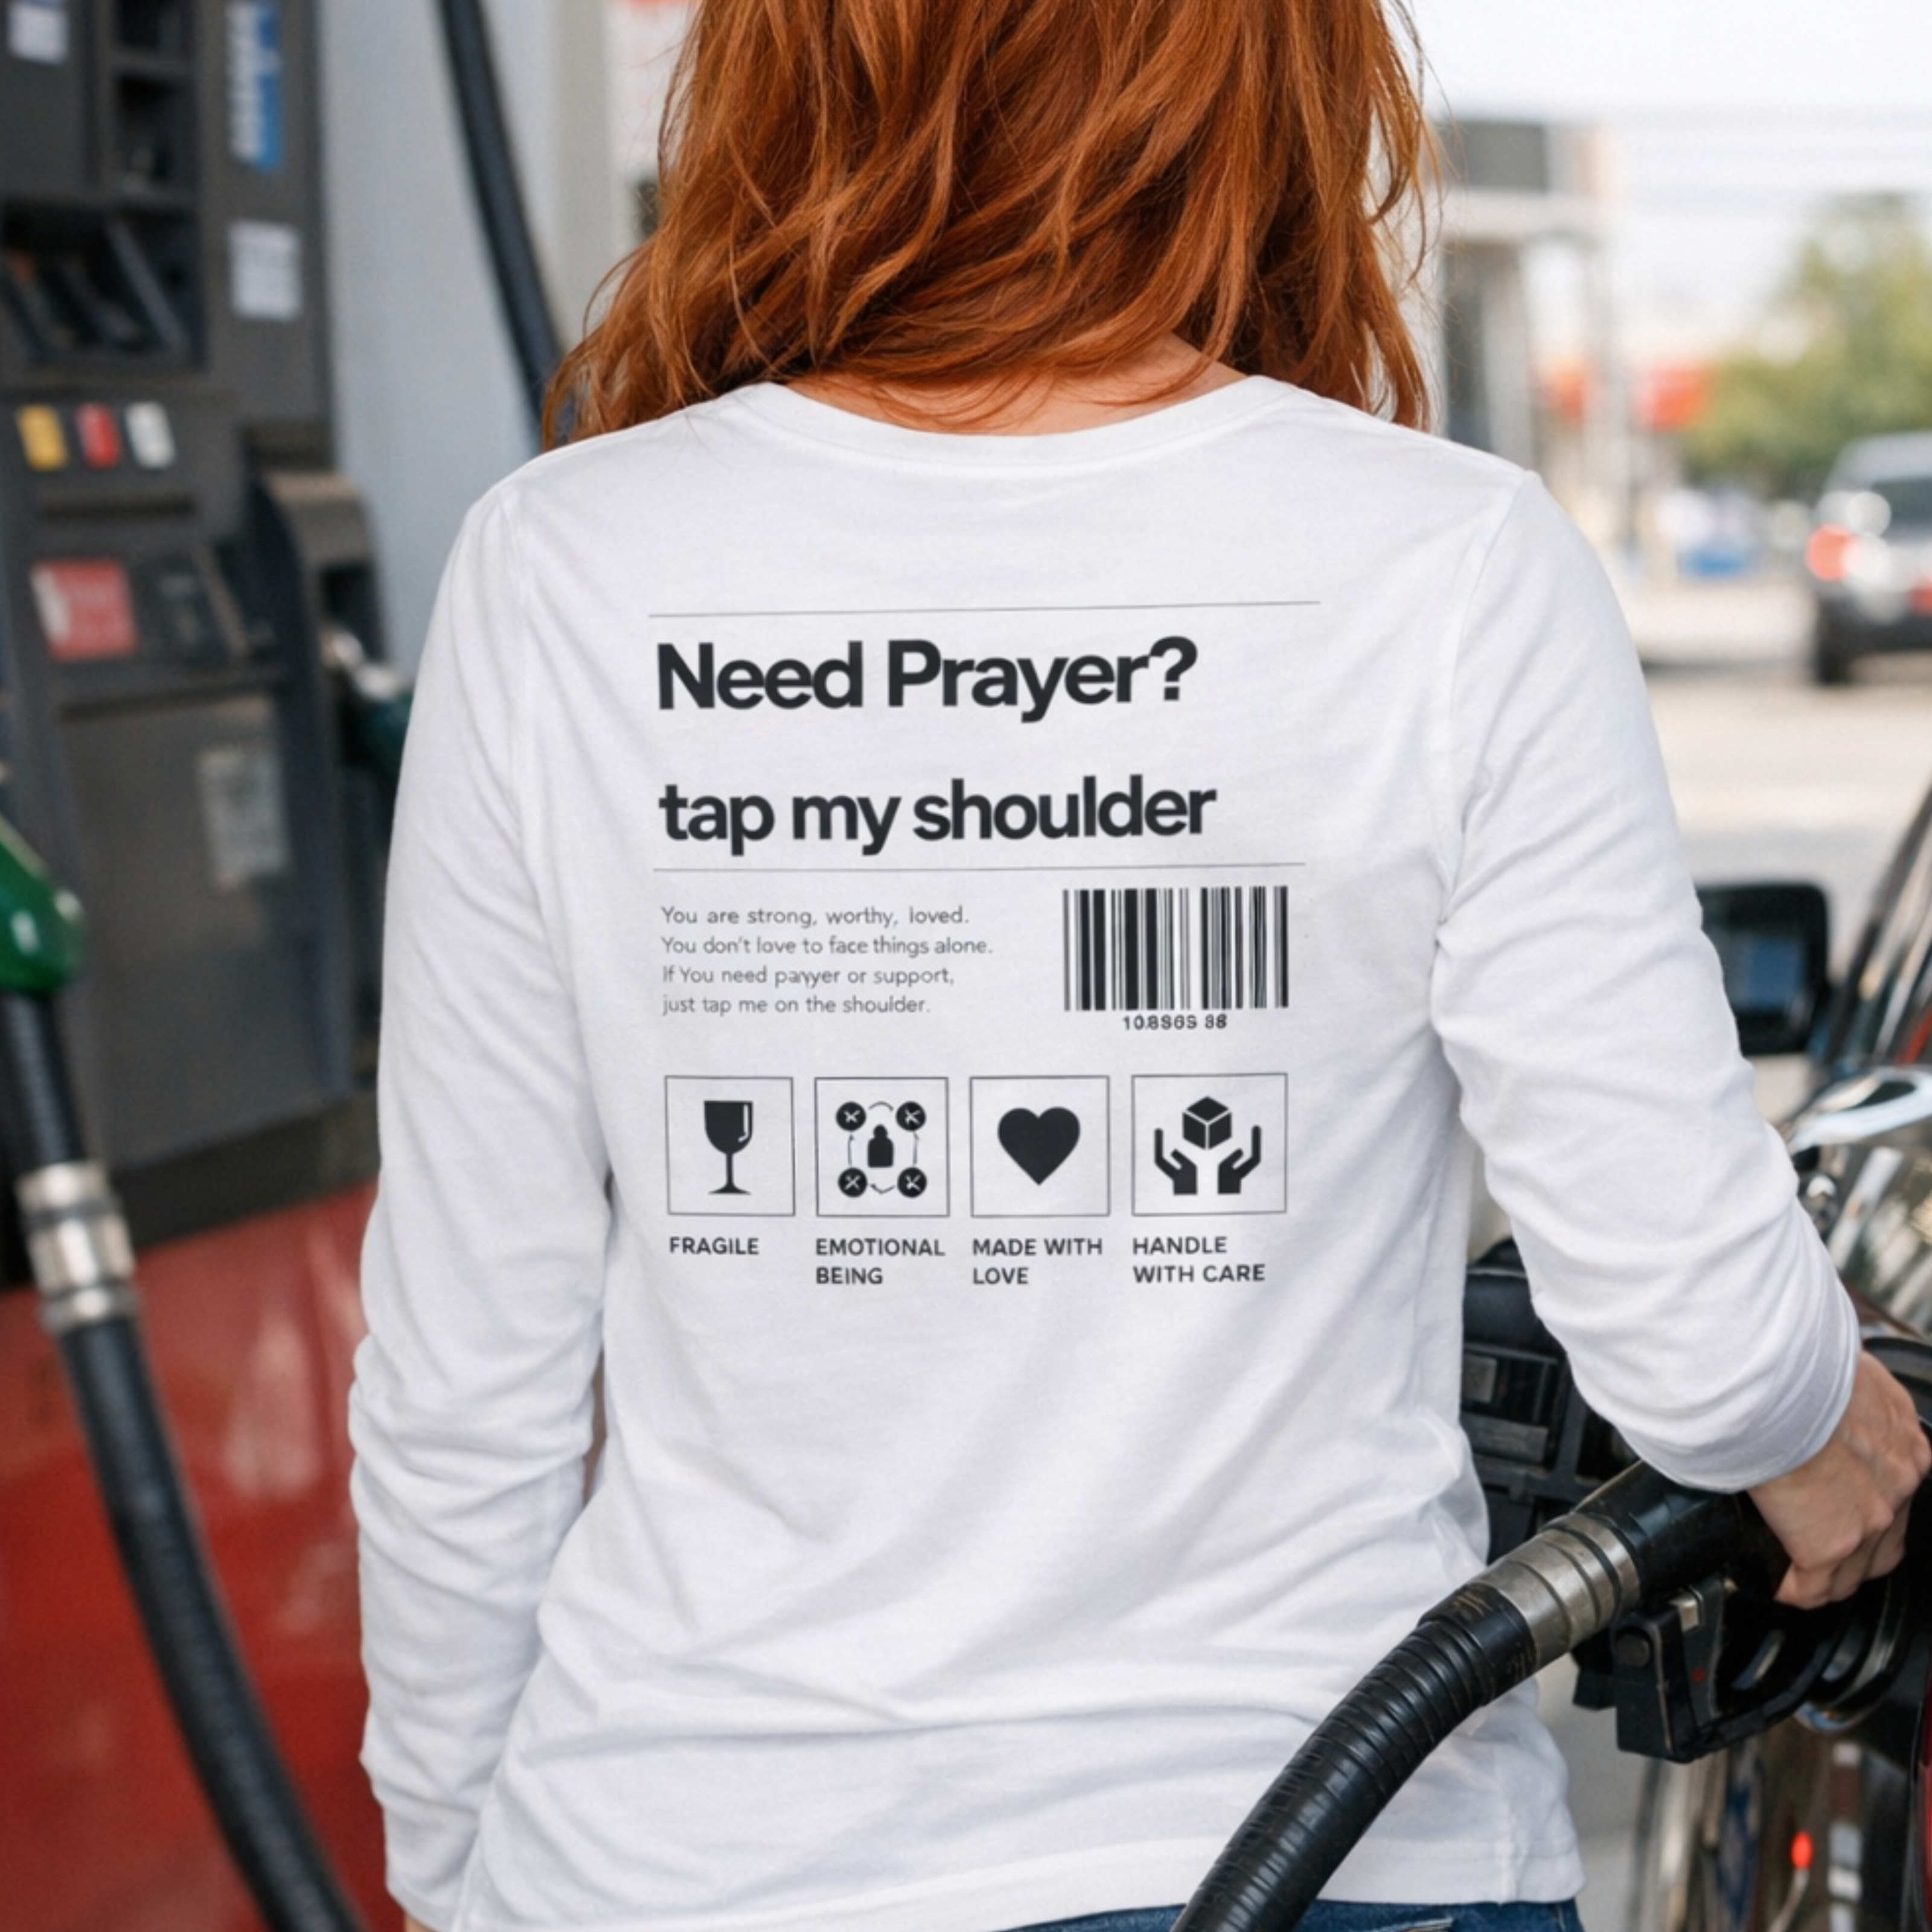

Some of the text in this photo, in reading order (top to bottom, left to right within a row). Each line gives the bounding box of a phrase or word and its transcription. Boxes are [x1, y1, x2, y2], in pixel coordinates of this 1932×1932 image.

[657, 636, 1198, 723] Need Prayer?
[659, 773, 1217, 856] tap my shoulder
[661, 905, 970, 929] You are strong, worthy, loved.
[661, 936, 697, 955] You
[756, 936, 796, 955] love
[802, 938, 823, 955] to
[829, 935, 868, 955] face
[872, 935, 930, 959] things
[934, 936, 994, 955] alone.
[663, 965, 675, 984] If
[679, 966, 714, 984] You
[721, 965, 767, 984] need
[847, 971, 867, 984] or
[873, 967, 955, 988] support,
[662, 994, 932, 1017] just tap me on the shoulder.
[670, 1236, 760, 1255] FRAGILE
[816, 1238, 945, 1256] EMOTIONAL
[973, 1238, 1103, 1256] MADE WITH
[1133, 1236, 1227, 1255] HANDLE
[816, 1266, 883, 1285] BEING
[973, 1267, 1029, 1285] LOVE
[1133, 1264, 1265, 1283] WITH CARE
